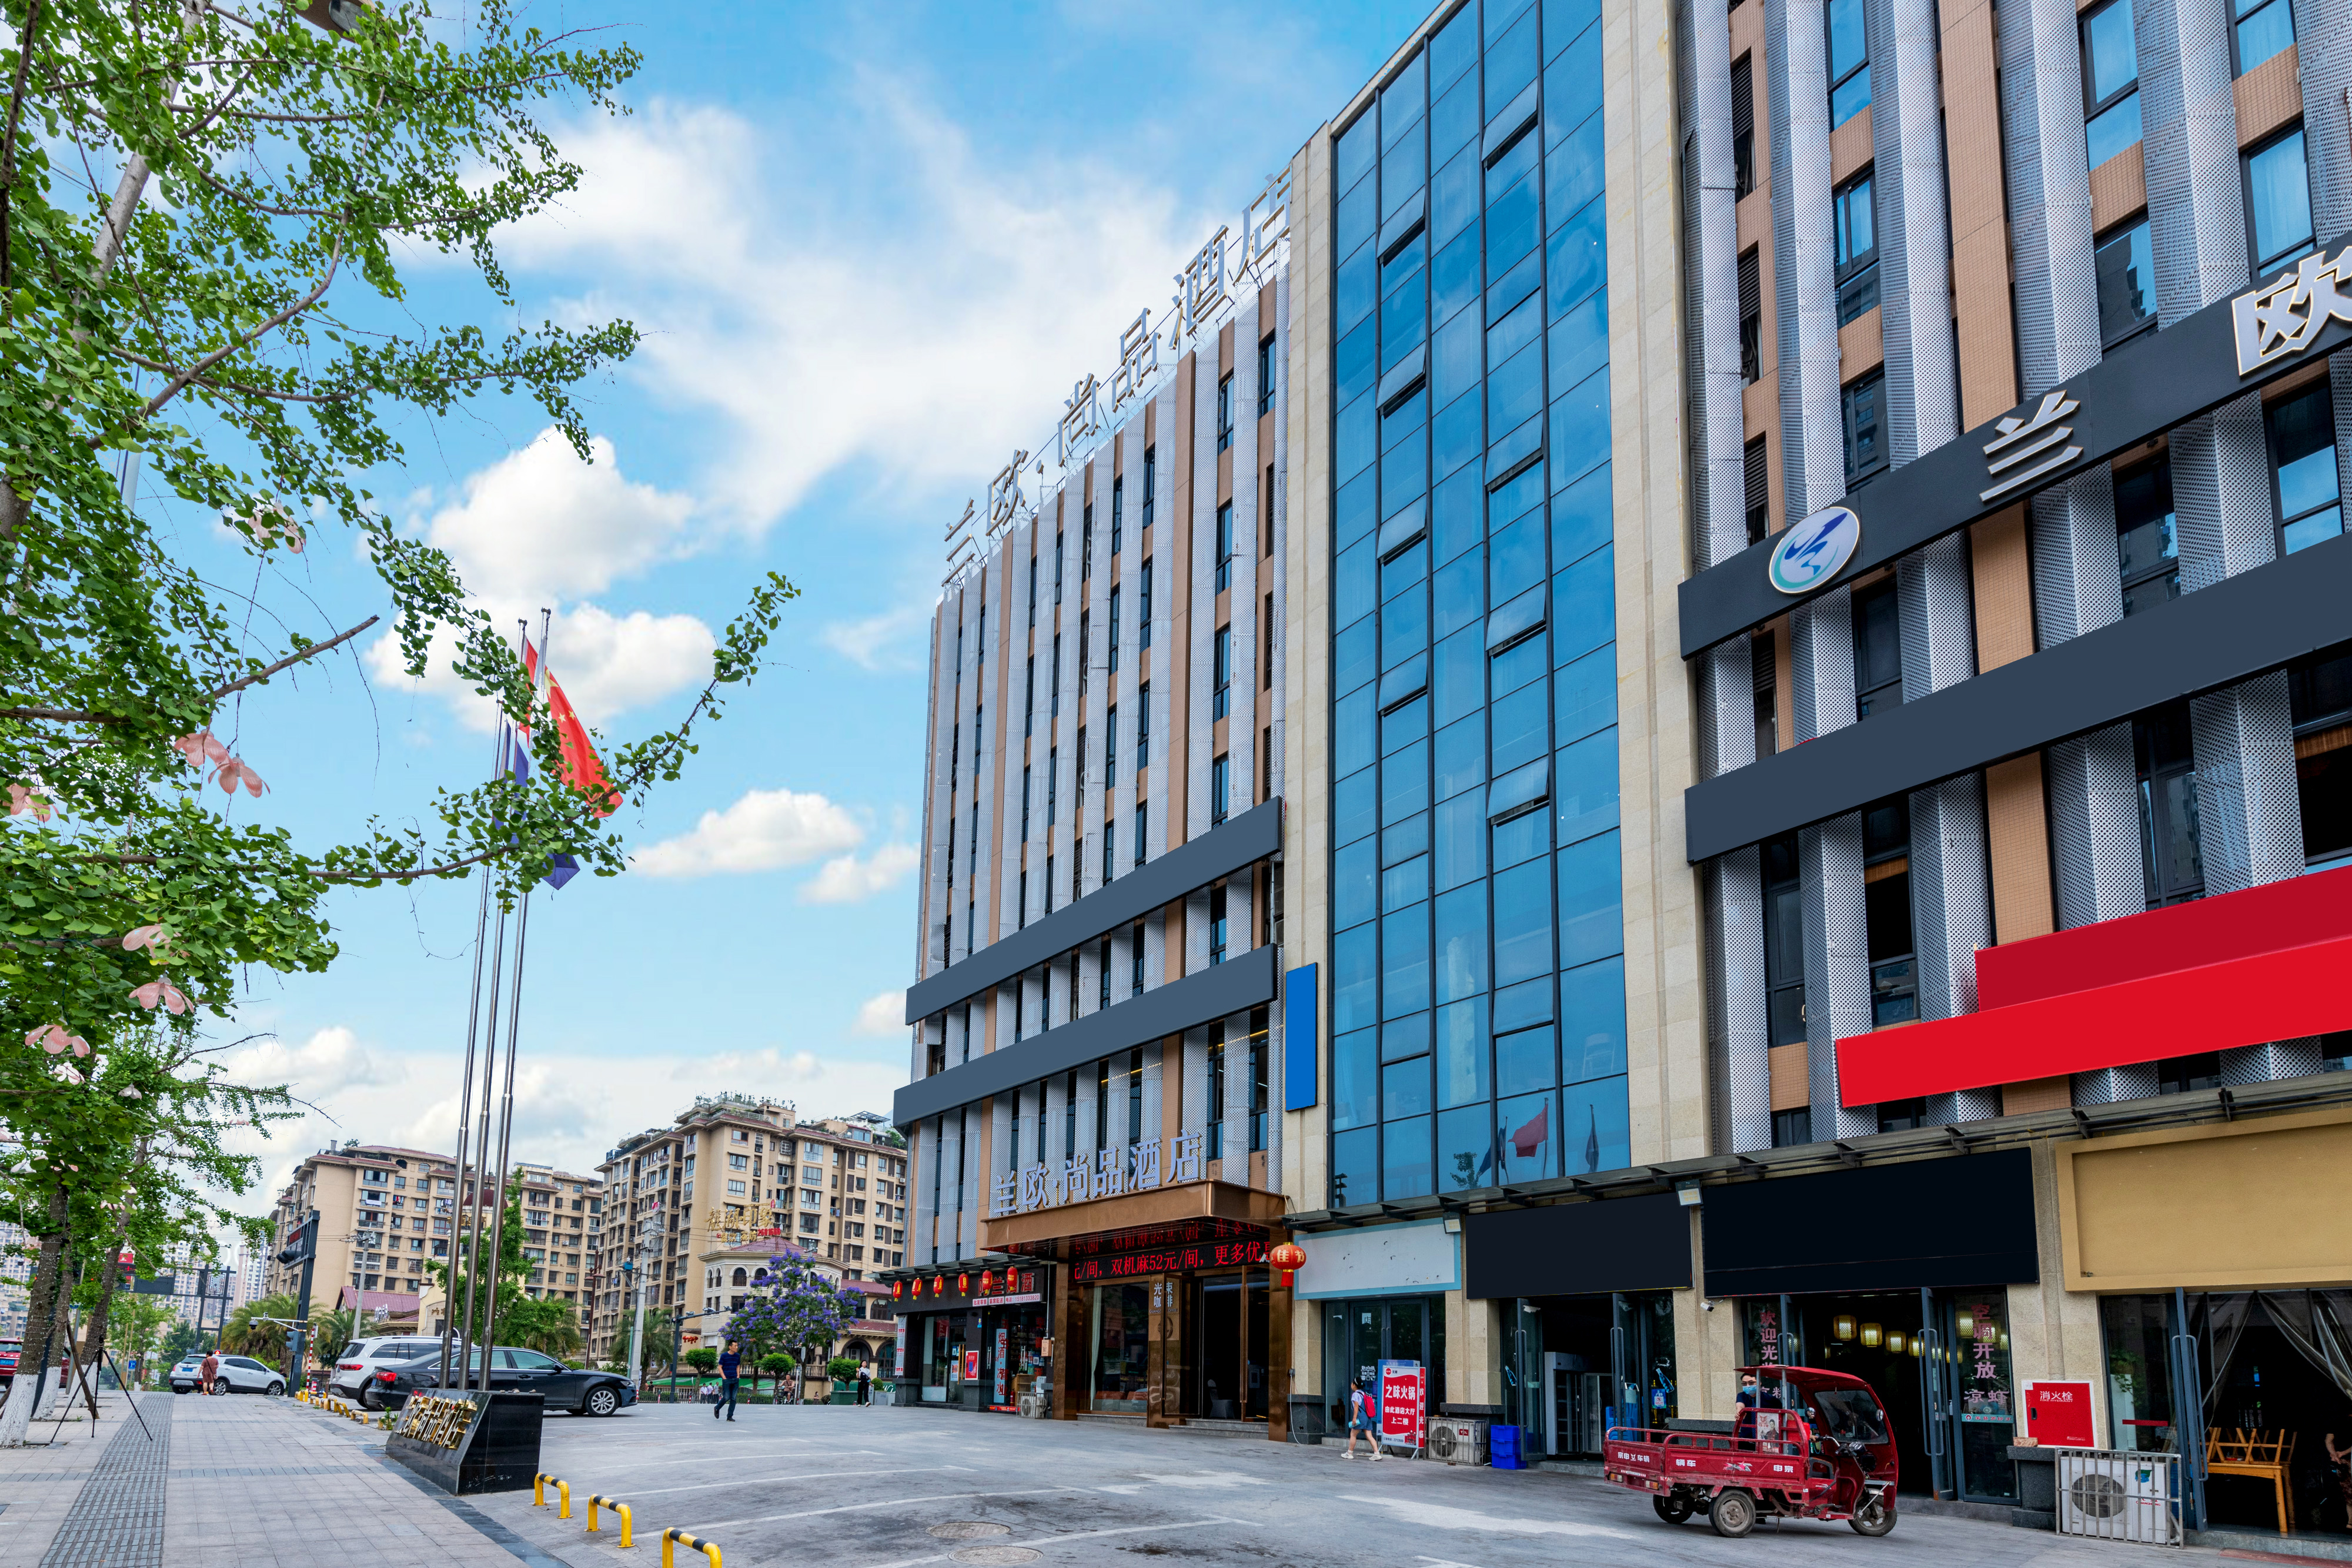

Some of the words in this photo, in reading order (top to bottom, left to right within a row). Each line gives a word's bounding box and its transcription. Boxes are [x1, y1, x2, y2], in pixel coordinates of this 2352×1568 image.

[994, 1129, 1201, 1213] 兰欧·尚品酒店
[1760, 1310, 1778, 1366] 欢迎光
[1970, 1303, 1997, 1379] 空调开放
[1385, 1385, 1416, 1400] 之味火锅
[1964, 1389, 2010, 1405] 凉虾
[2040, 1391, 2073, 1400] 消火栓
[1385, 1406, 1415, 1416] 由此酒店大厅
[1391, 1417, 1409, 1426] 上二楼
[1618, 1452, 1629, 1460] 宗申
[1637, 1455, 1650, 1463] 车辆
